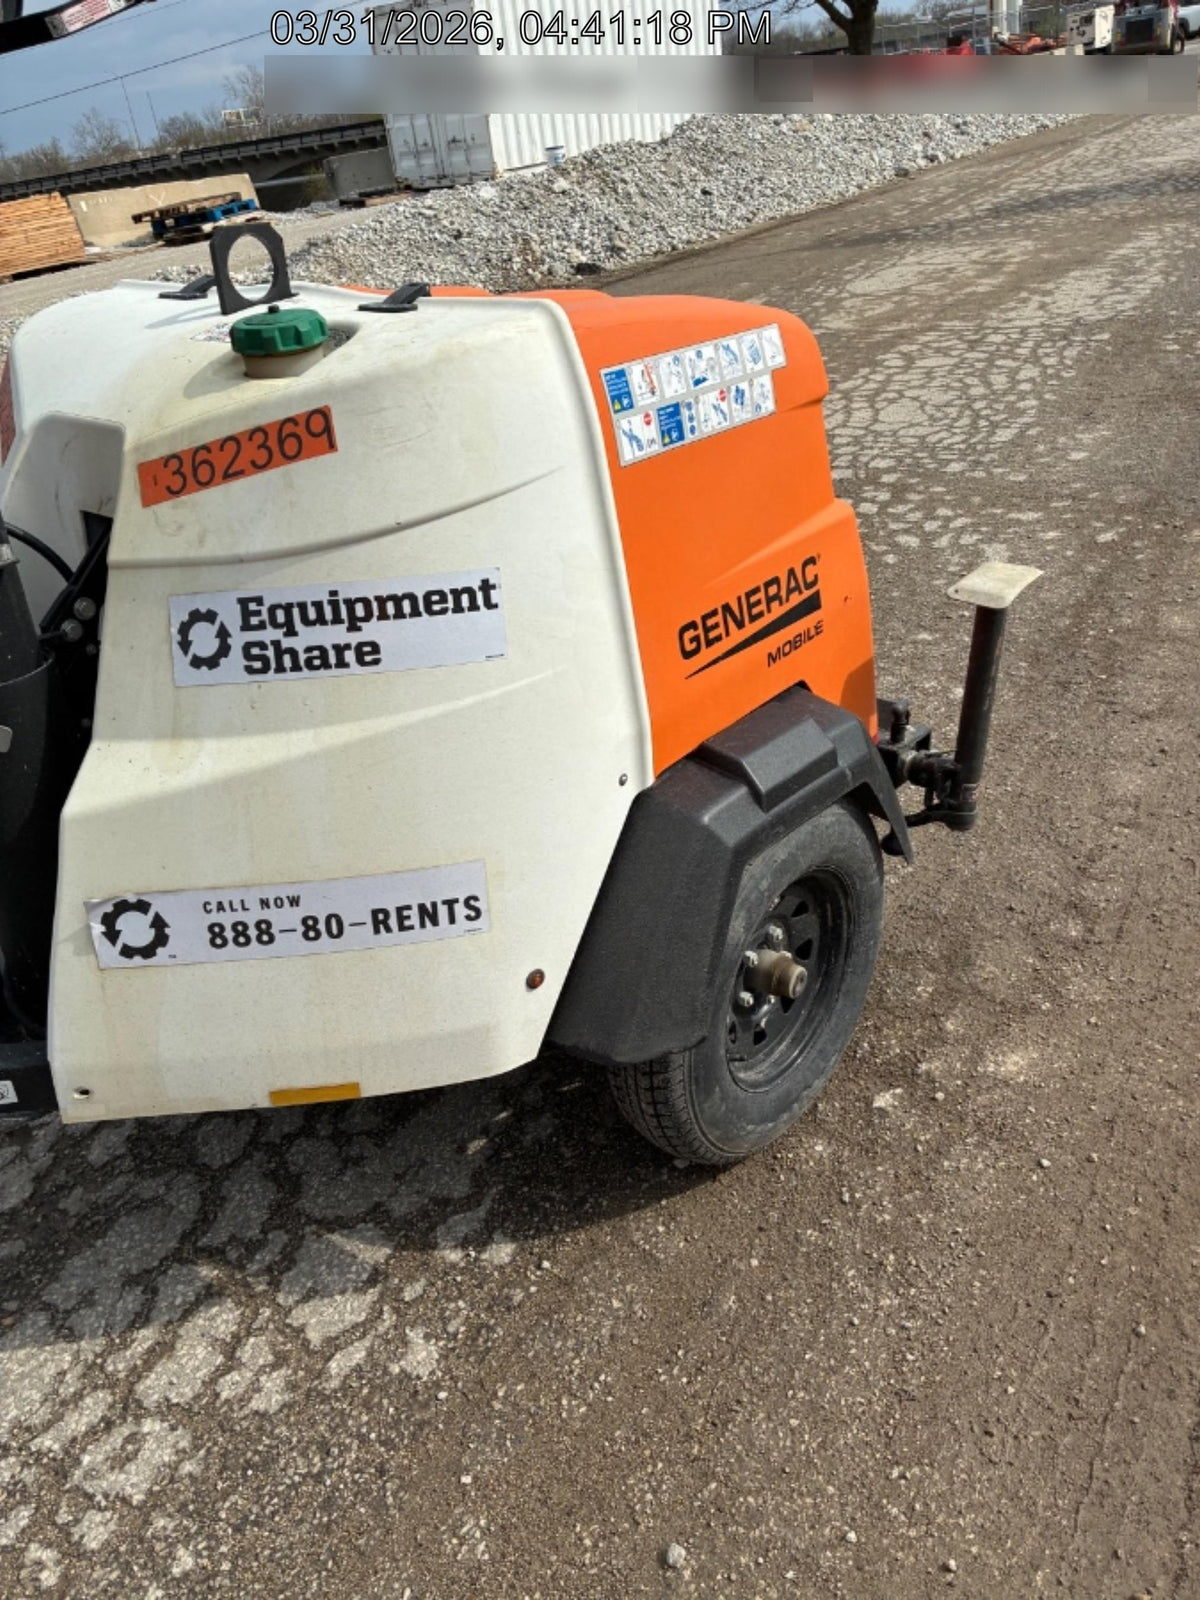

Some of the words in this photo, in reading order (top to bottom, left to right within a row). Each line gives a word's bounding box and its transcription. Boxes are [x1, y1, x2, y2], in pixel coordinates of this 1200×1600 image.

[163, 408, 335, 495] 362369
[236, 577, 499, 637] Equipment
[678, 555, 819, 660] GENERAC
[241, 638, 382, 675] Share
[767, 620, 823, 667] MOBILE
[203, 898, 251, 914] CALL
[260, 894, 301, 910] NOW
[207, 894, 482, 950] 888-80-RENTS
